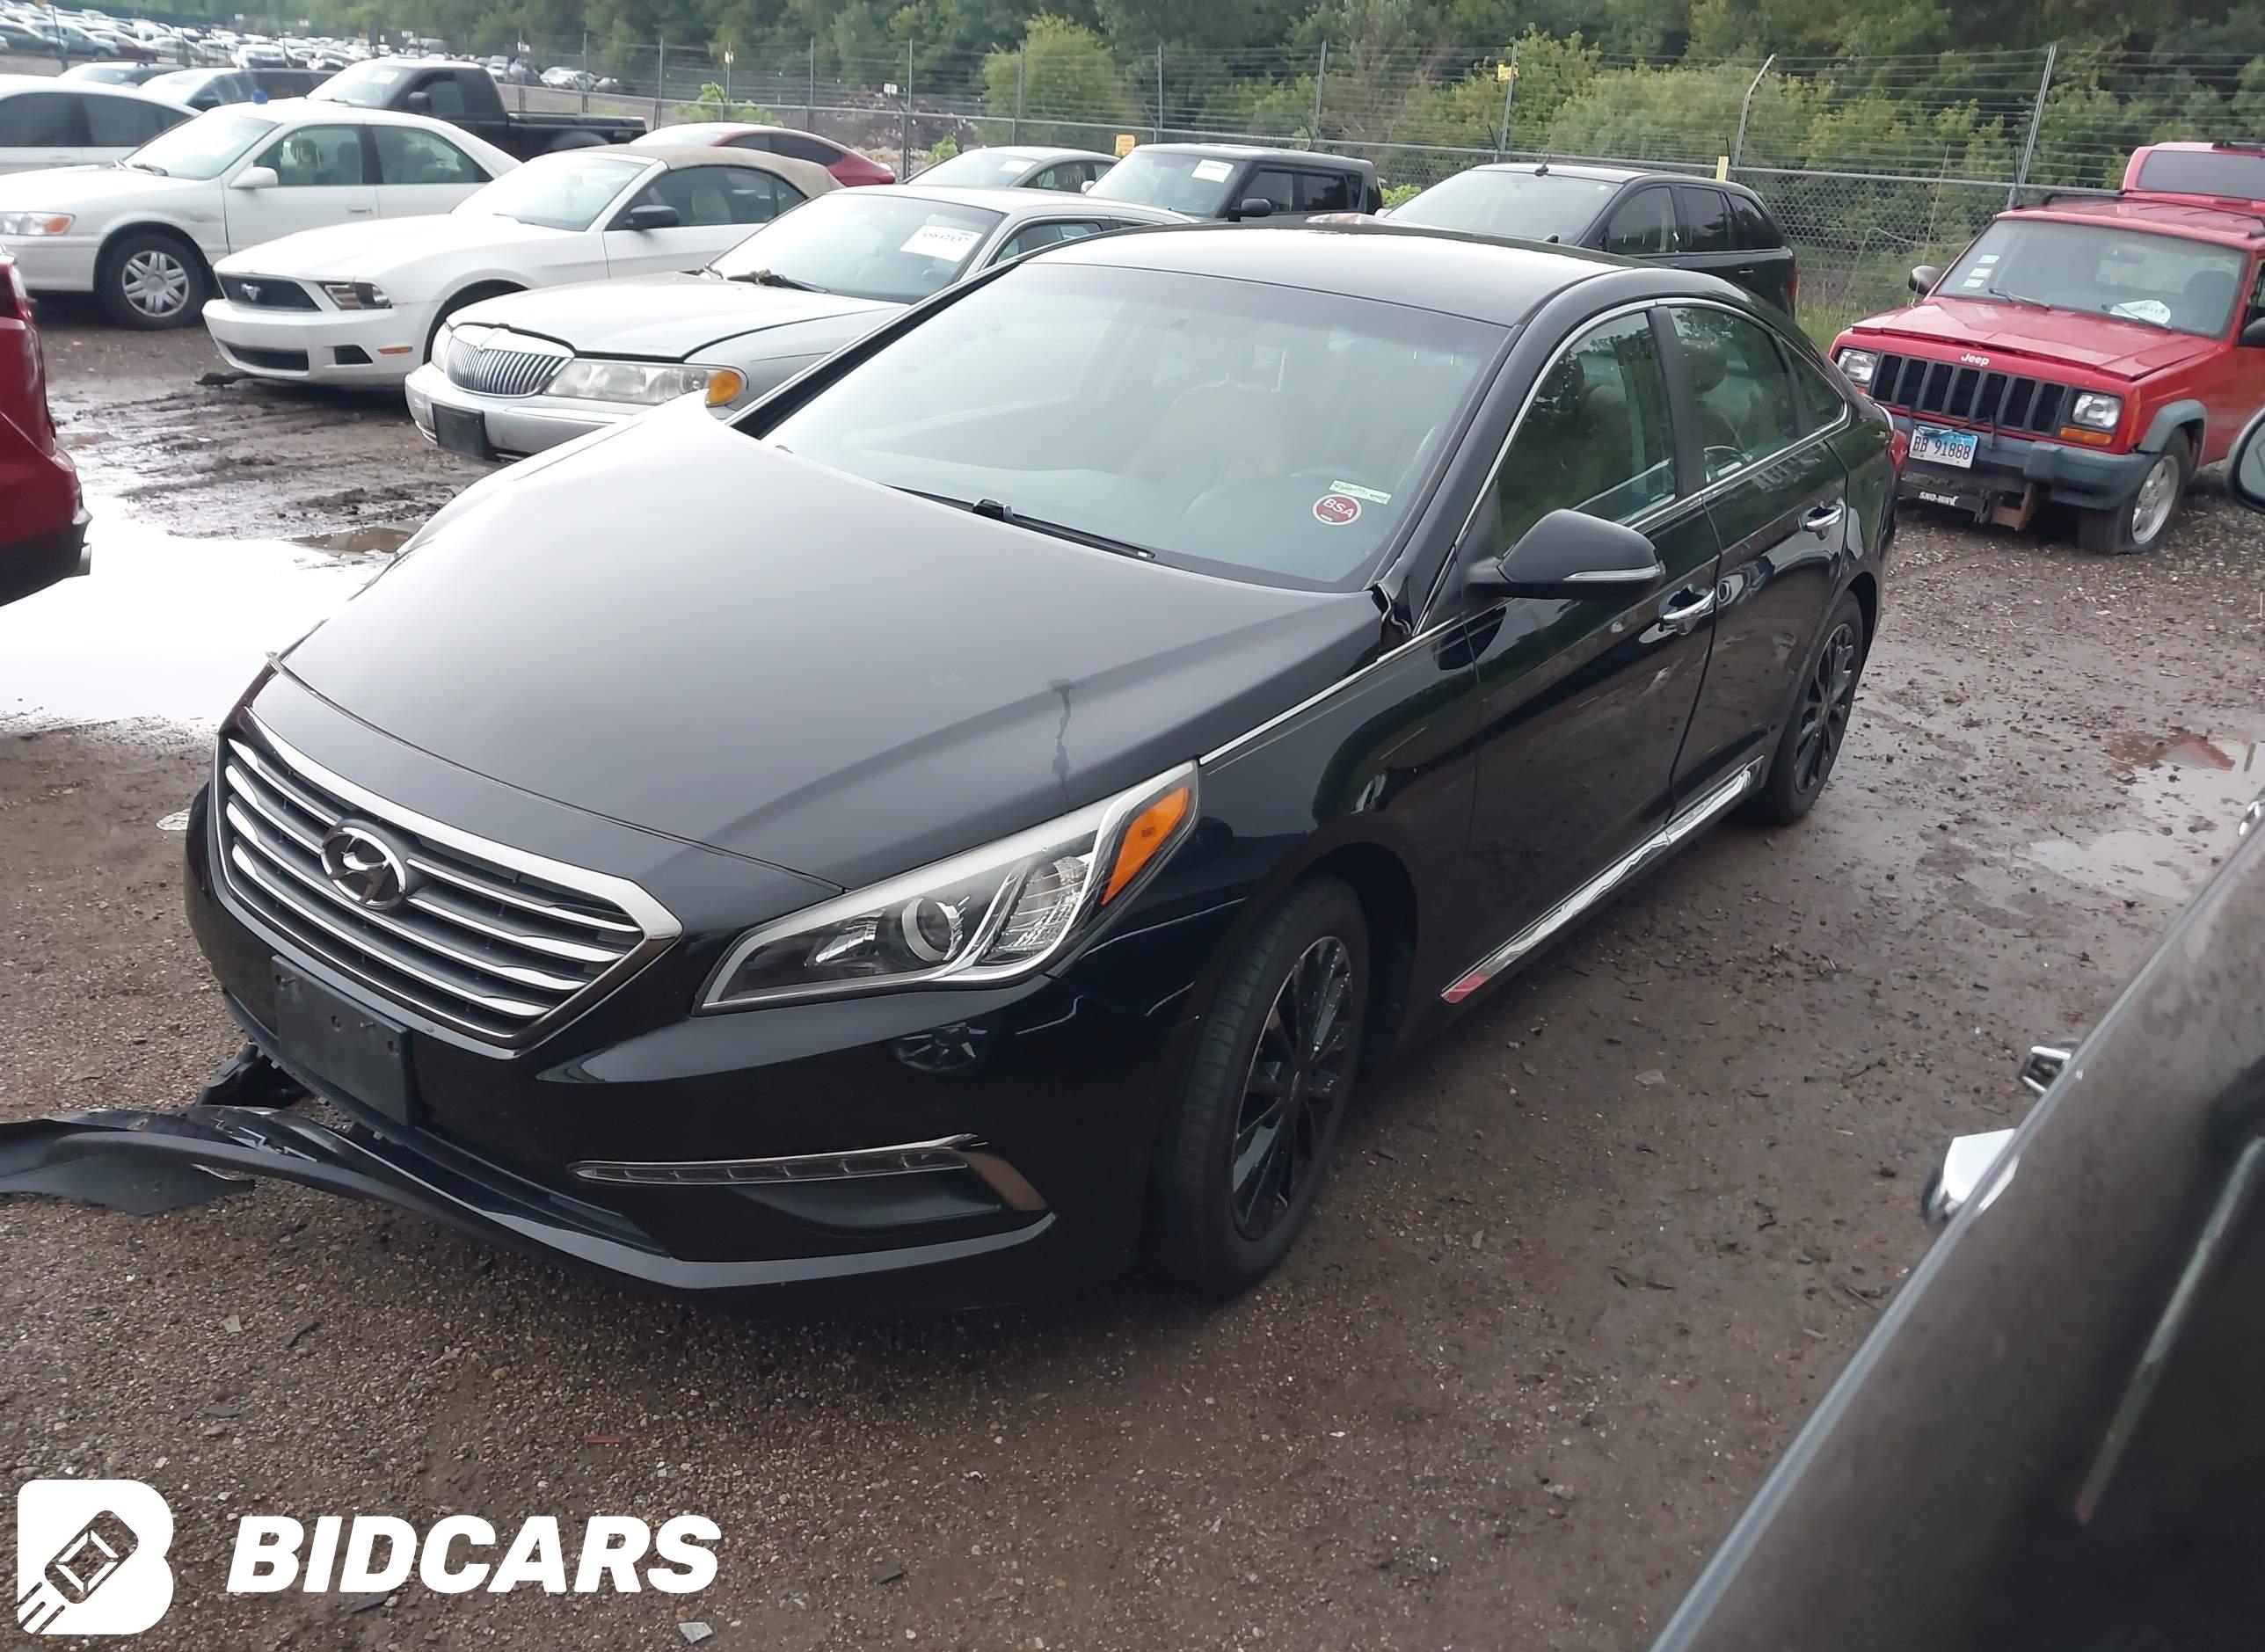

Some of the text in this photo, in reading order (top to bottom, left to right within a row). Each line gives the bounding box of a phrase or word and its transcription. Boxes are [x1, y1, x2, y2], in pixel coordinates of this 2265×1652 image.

[1960, 353, 1990, 367] Jeep
[1934, 440, 1971, 460] 91888
[1919, 491, 1959, 506] SNO-WAY
[1322, 498, 1354, 519] BSA
